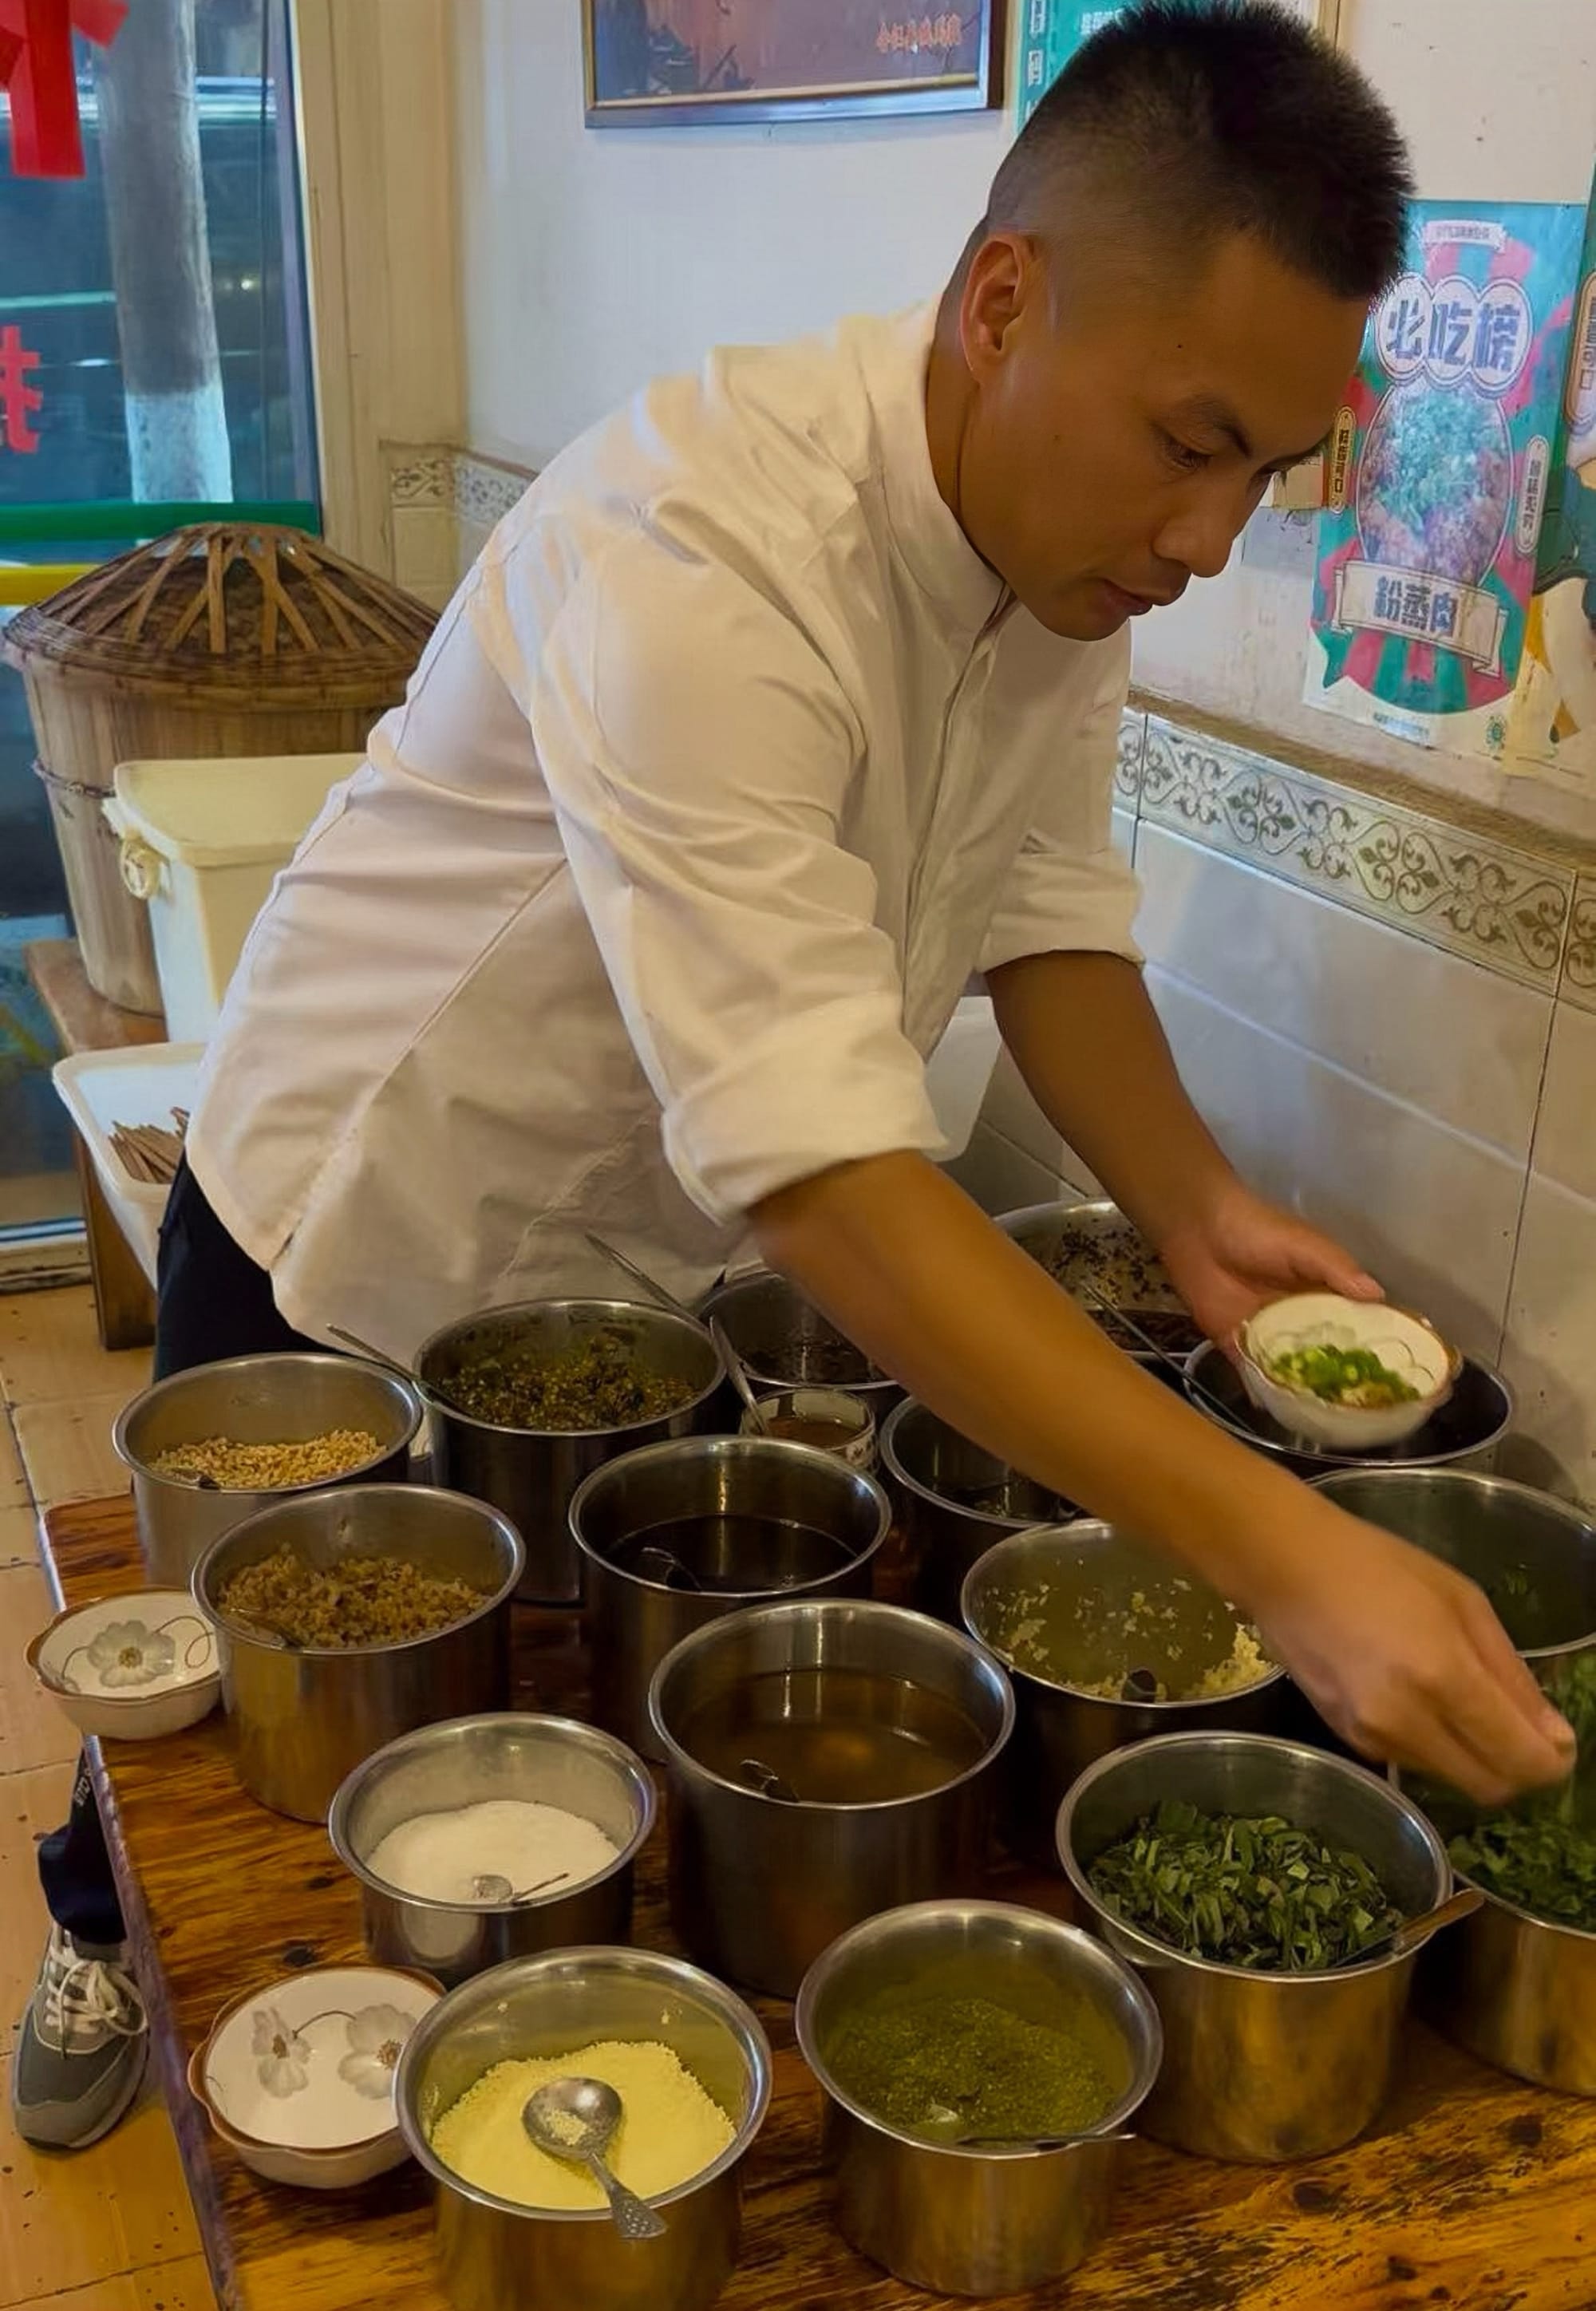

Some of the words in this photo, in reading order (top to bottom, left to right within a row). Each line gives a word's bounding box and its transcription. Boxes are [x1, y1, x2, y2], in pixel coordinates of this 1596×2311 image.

[1386, 298, 1520, 372] 必吃榜
[1373, 575, 1458, 637] 粉蒸肉
